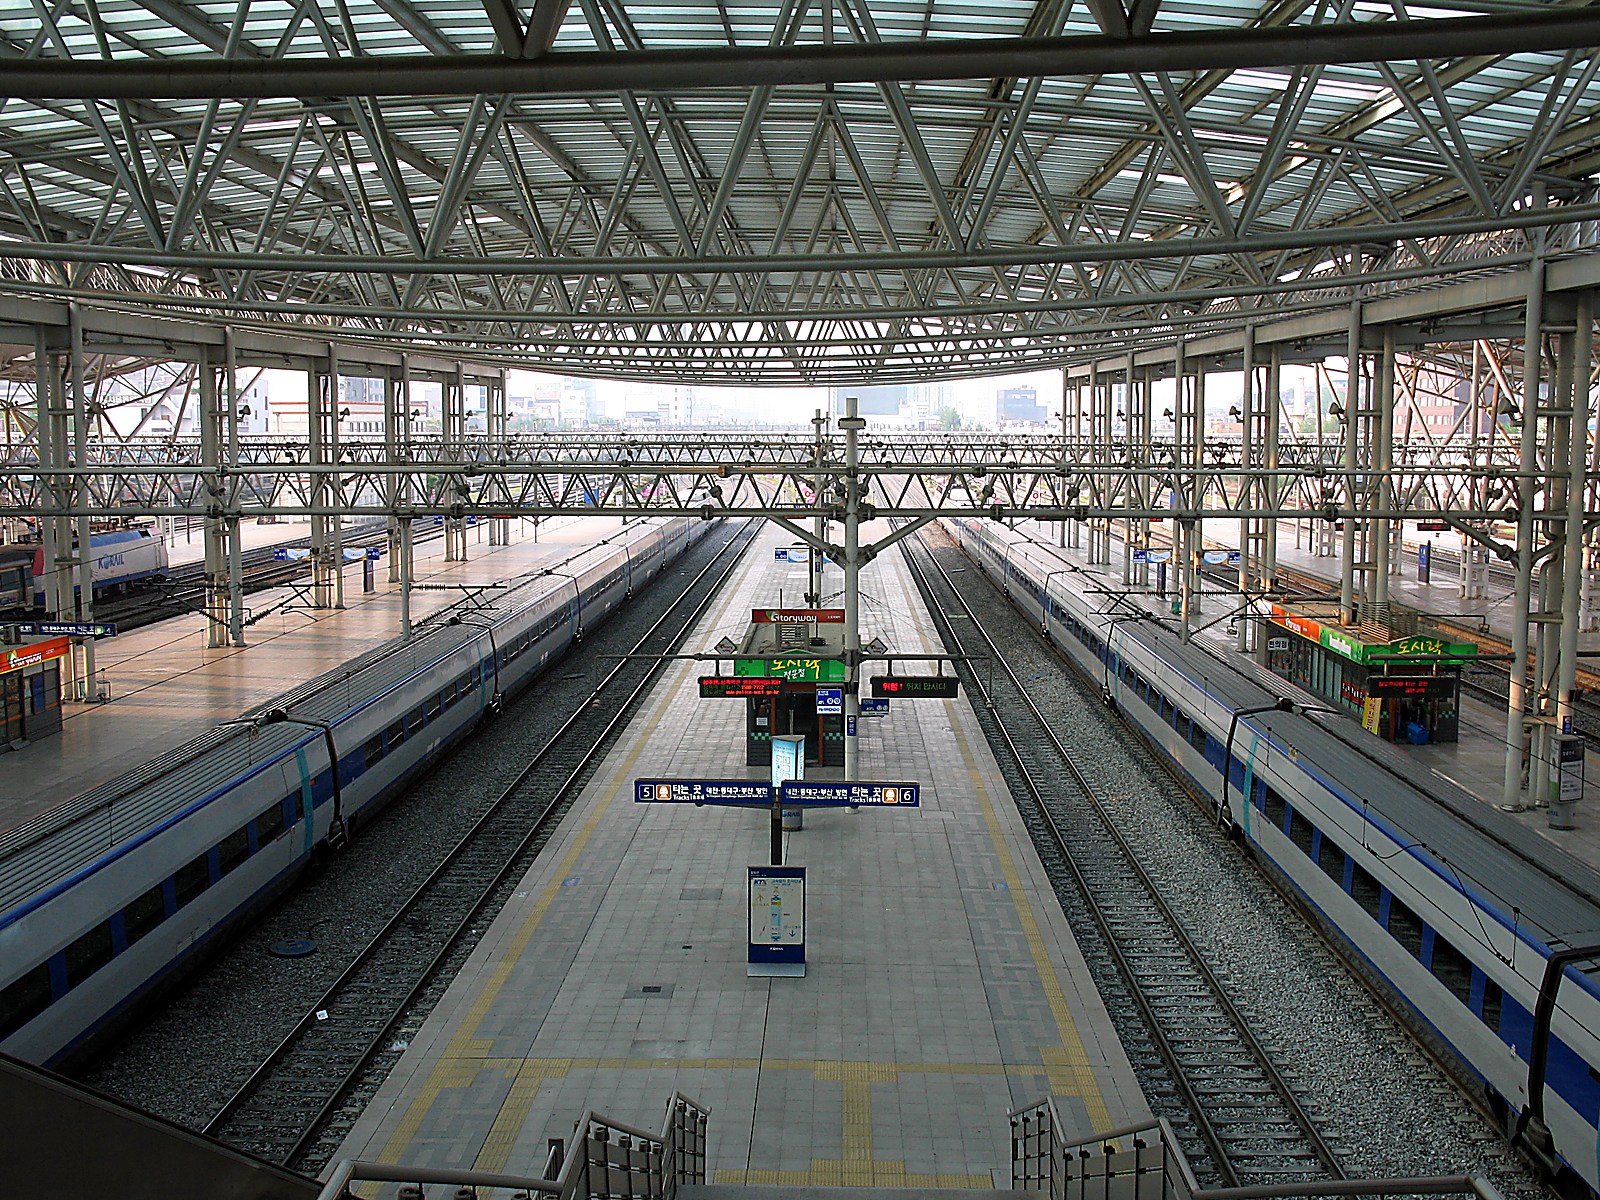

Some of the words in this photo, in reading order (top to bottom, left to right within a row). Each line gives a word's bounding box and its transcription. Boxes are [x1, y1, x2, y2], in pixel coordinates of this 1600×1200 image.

[98, 553, 125, 570] KORAIL
[771, 613, 817, 624] Storyway
[1397, 639, 1445, 657] 도시락
[643, 787, 650, 798] 5
[672, 785, 689, 795] 타는
[693, 785, 702, 795] 곳
[851, 787, 869, 797] 타는
[872, 787, 882, 798] 곳
[903, 791, 911, 800] 6
